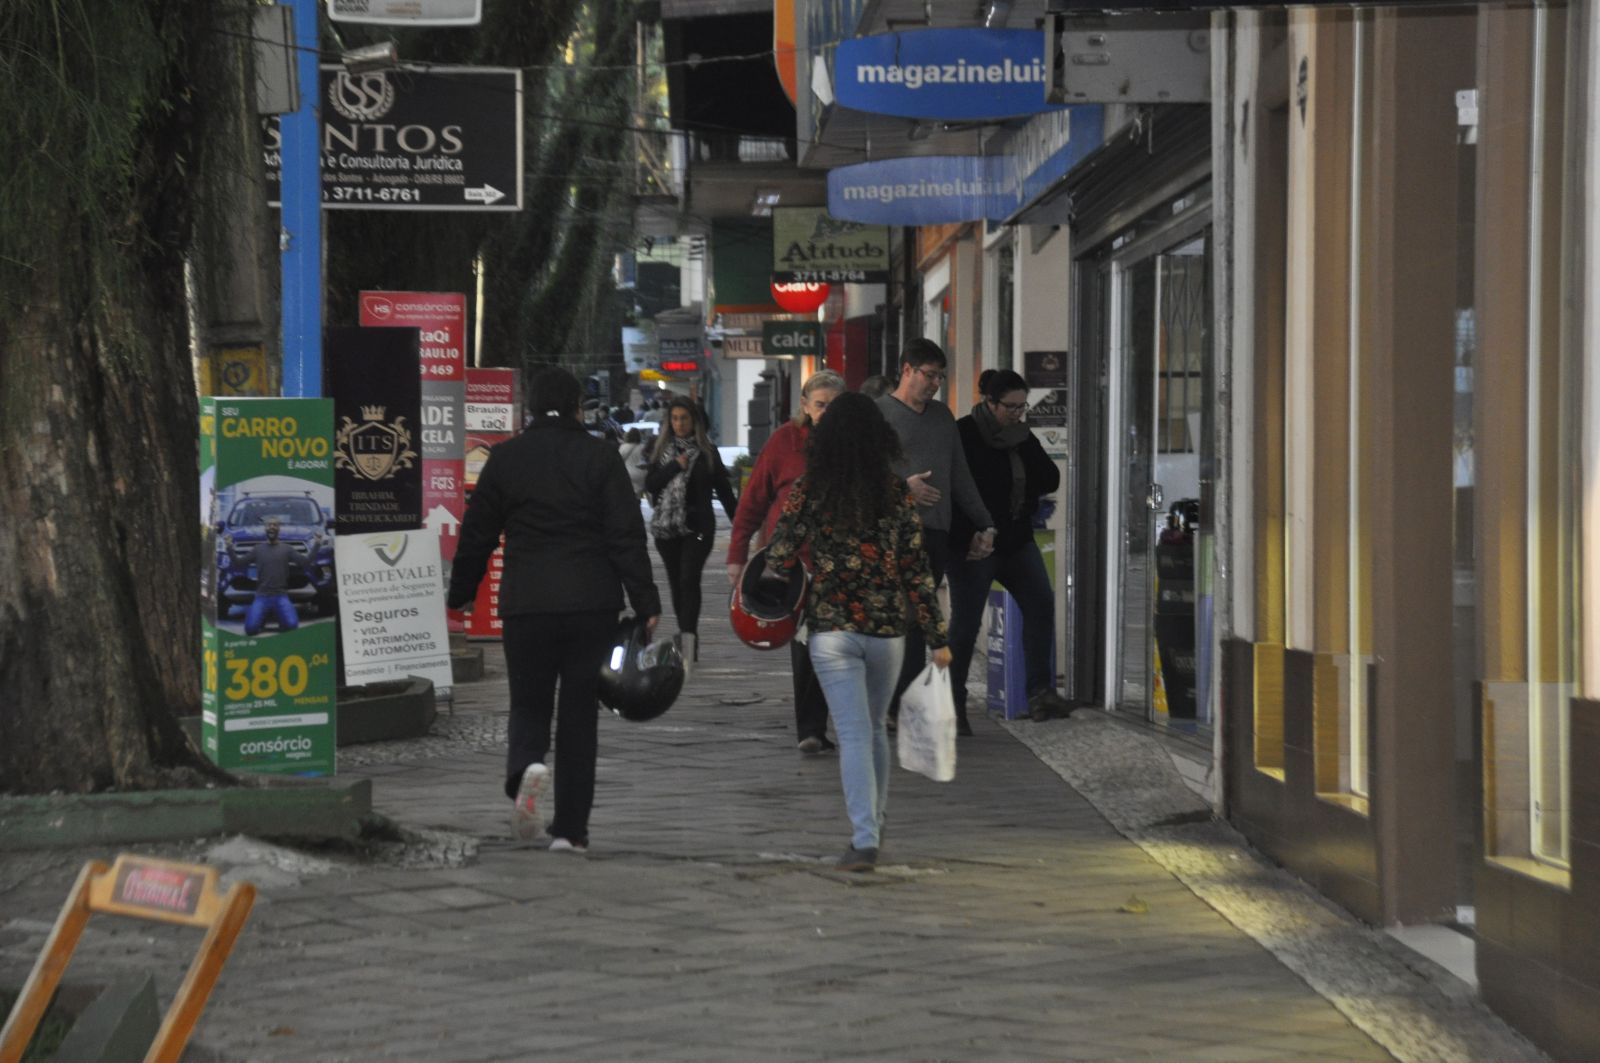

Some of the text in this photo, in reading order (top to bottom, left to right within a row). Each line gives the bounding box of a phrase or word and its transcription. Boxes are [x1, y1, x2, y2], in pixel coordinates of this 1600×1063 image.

[262, 120, 464, 153] SNTOS
[339, 153, 410, 171] Consultoria
[333, 186, 421, 202] 3711-6761
[430, 365, 454, 377] 469
[222, 416, 298, 438] CARRO
[262, 436, 329, 459] NOVO
[356, 435, 393, 450] ITS
[341, 564, 437, 586] PROTEVALE
[352, 606, 420, 624] Seguros
[360, 626, 388, 636] VIDA
[361, 631, 432, 647] PATRIMÔNIO
[362, 640, 437, 657] AUTOMÓVEIS
[239, 735, 313, 755] consórcio
